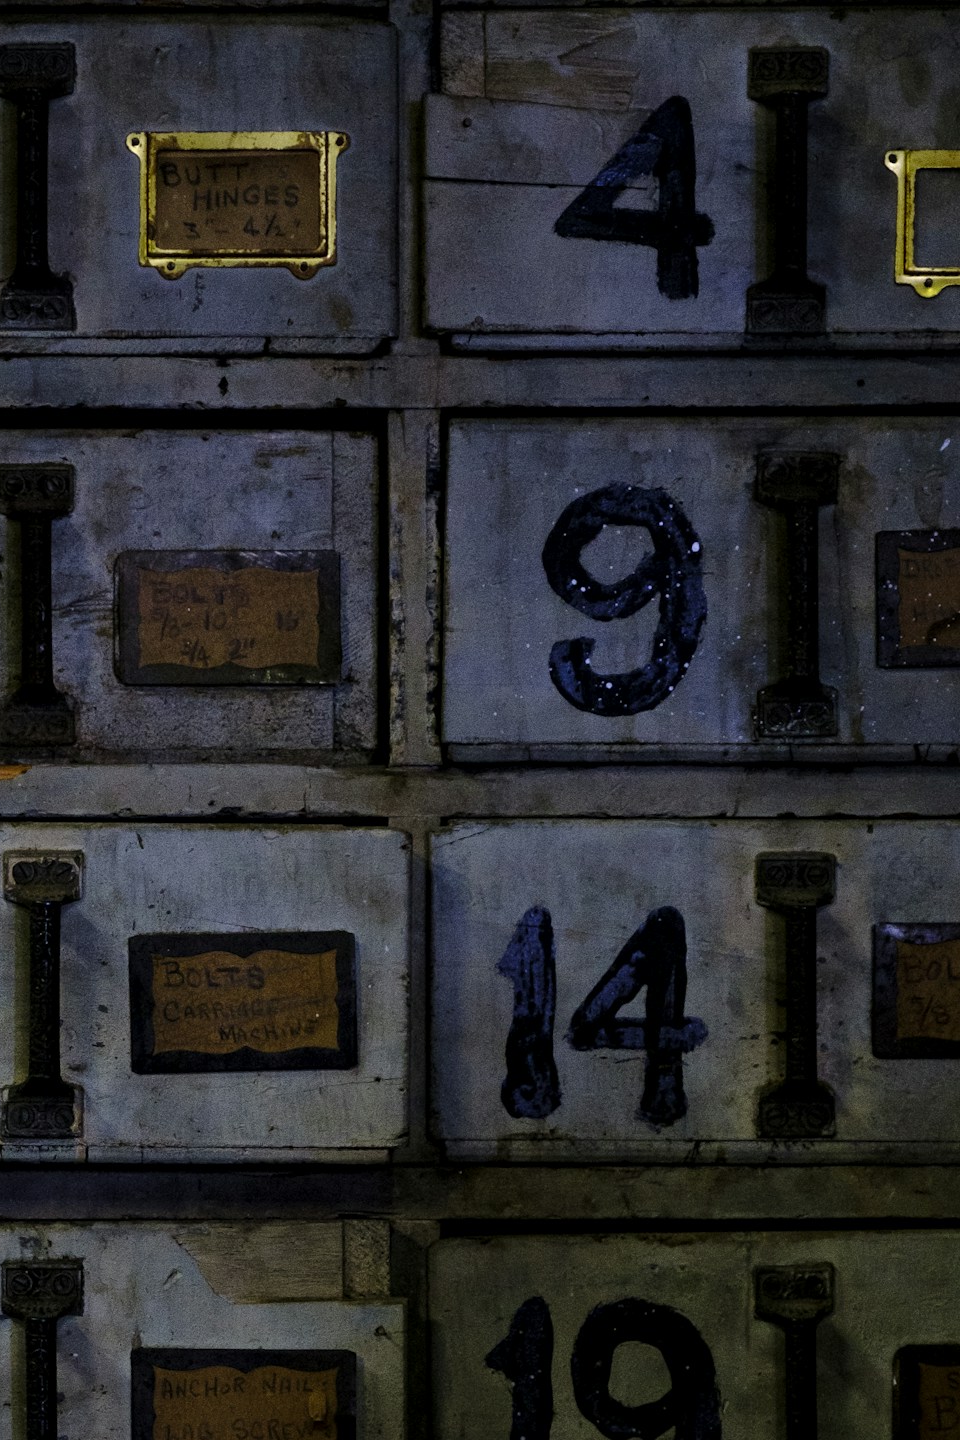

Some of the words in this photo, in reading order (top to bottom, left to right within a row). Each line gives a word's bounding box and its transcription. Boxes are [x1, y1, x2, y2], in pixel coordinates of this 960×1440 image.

[158, 161, 248, 187] BUTT
[192, 184, 299, 211] HINGES
[554, 96, 714, 299] 4
[150, 580, 250, 607] BOLTS
[542, 484, 708, 717] 9
[161, 961, 265, 989] BOLTS
[497, 905, 709, 1126] 14
[219, 1019, 319, 1042] MACHINE
[161, 1375, 246, 1399] ANCHOR
